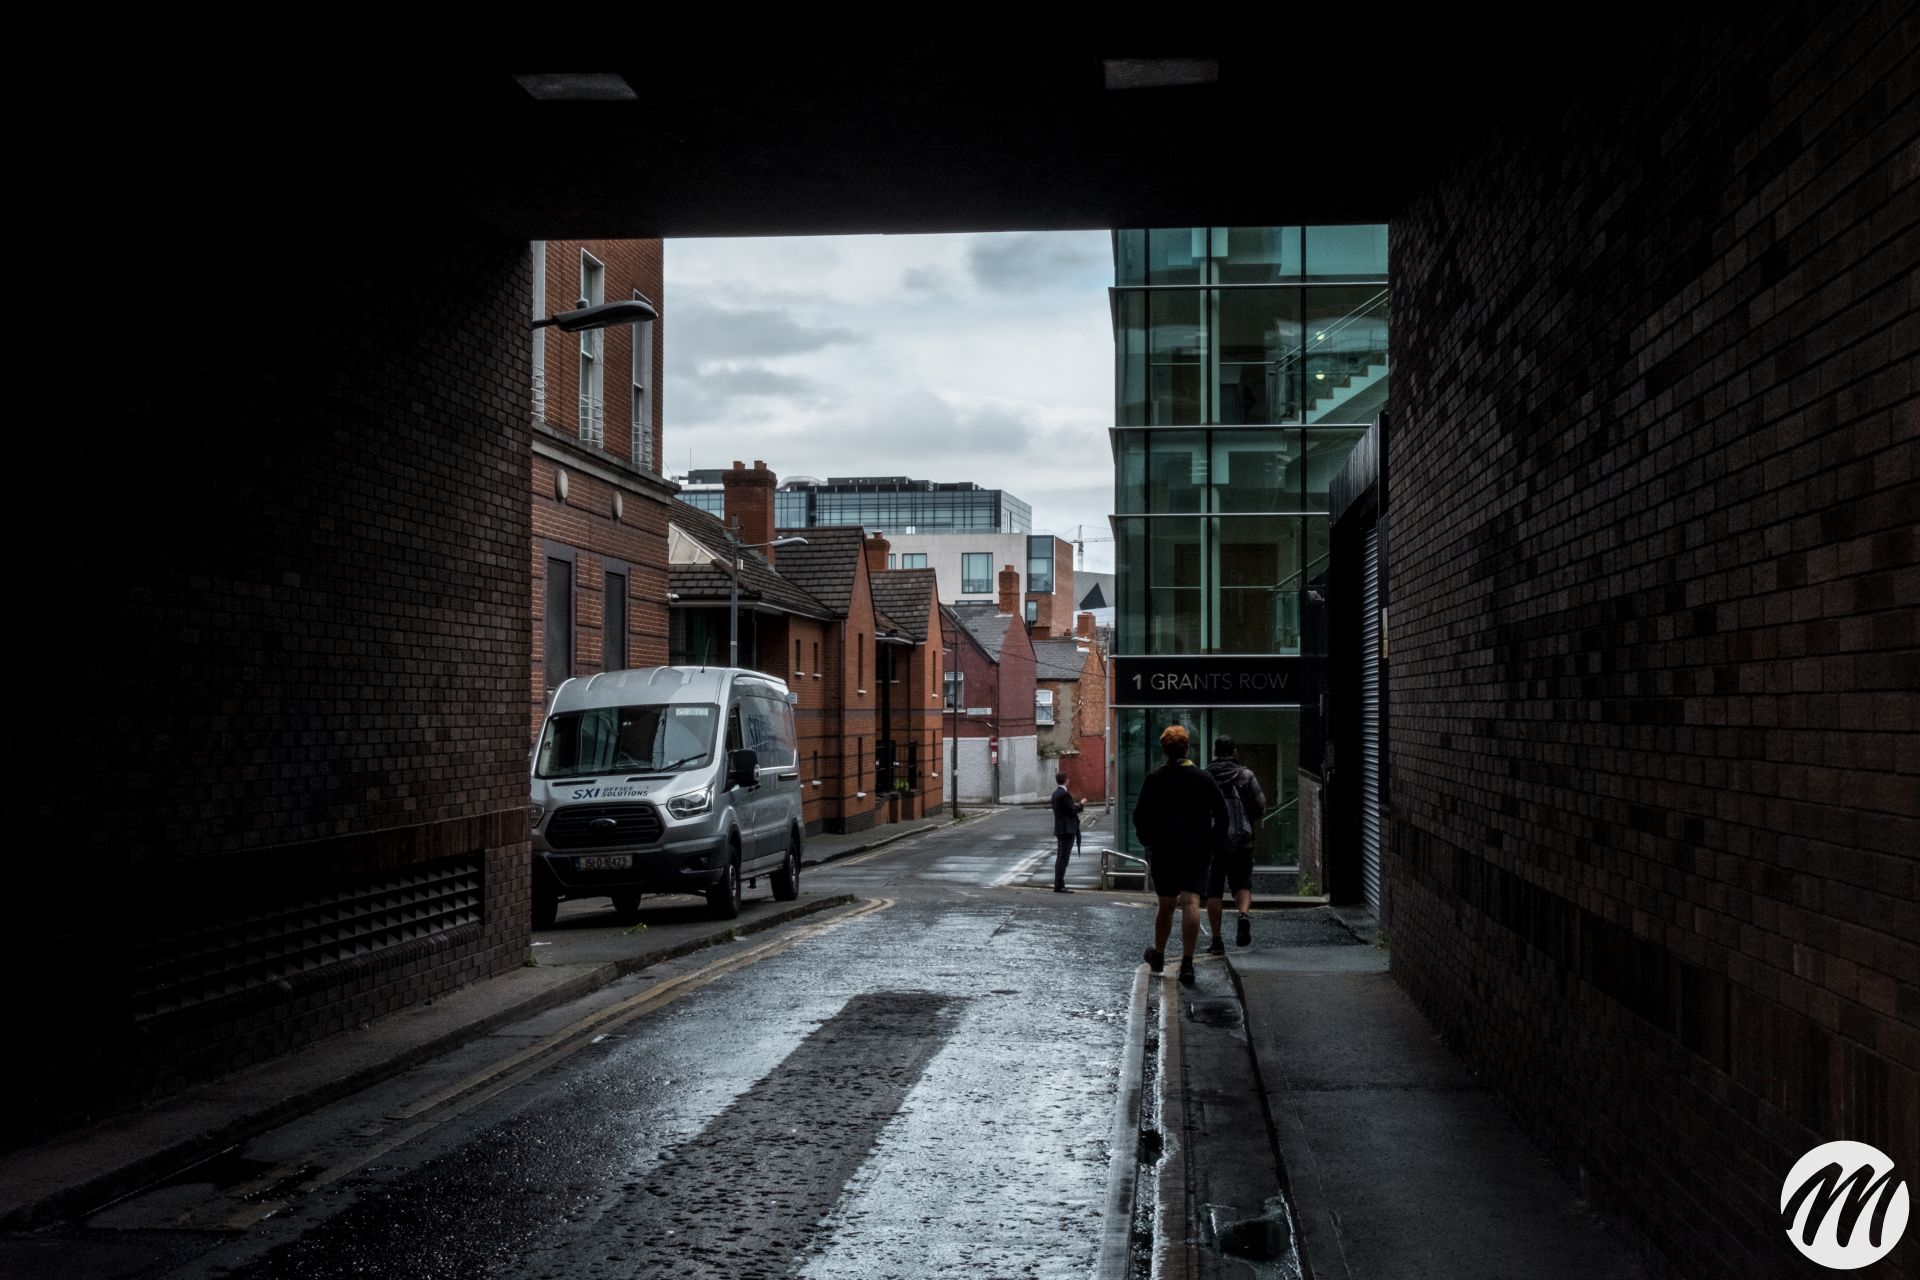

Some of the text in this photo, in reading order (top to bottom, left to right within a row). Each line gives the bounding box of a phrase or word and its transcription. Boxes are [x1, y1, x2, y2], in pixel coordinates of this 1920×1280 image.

[1132, 672, 1289, 691] 1 GRANTS ROW
[572, 788, 600, 800] SXI
[601, 790, 648, 798] SOLUTIONS
